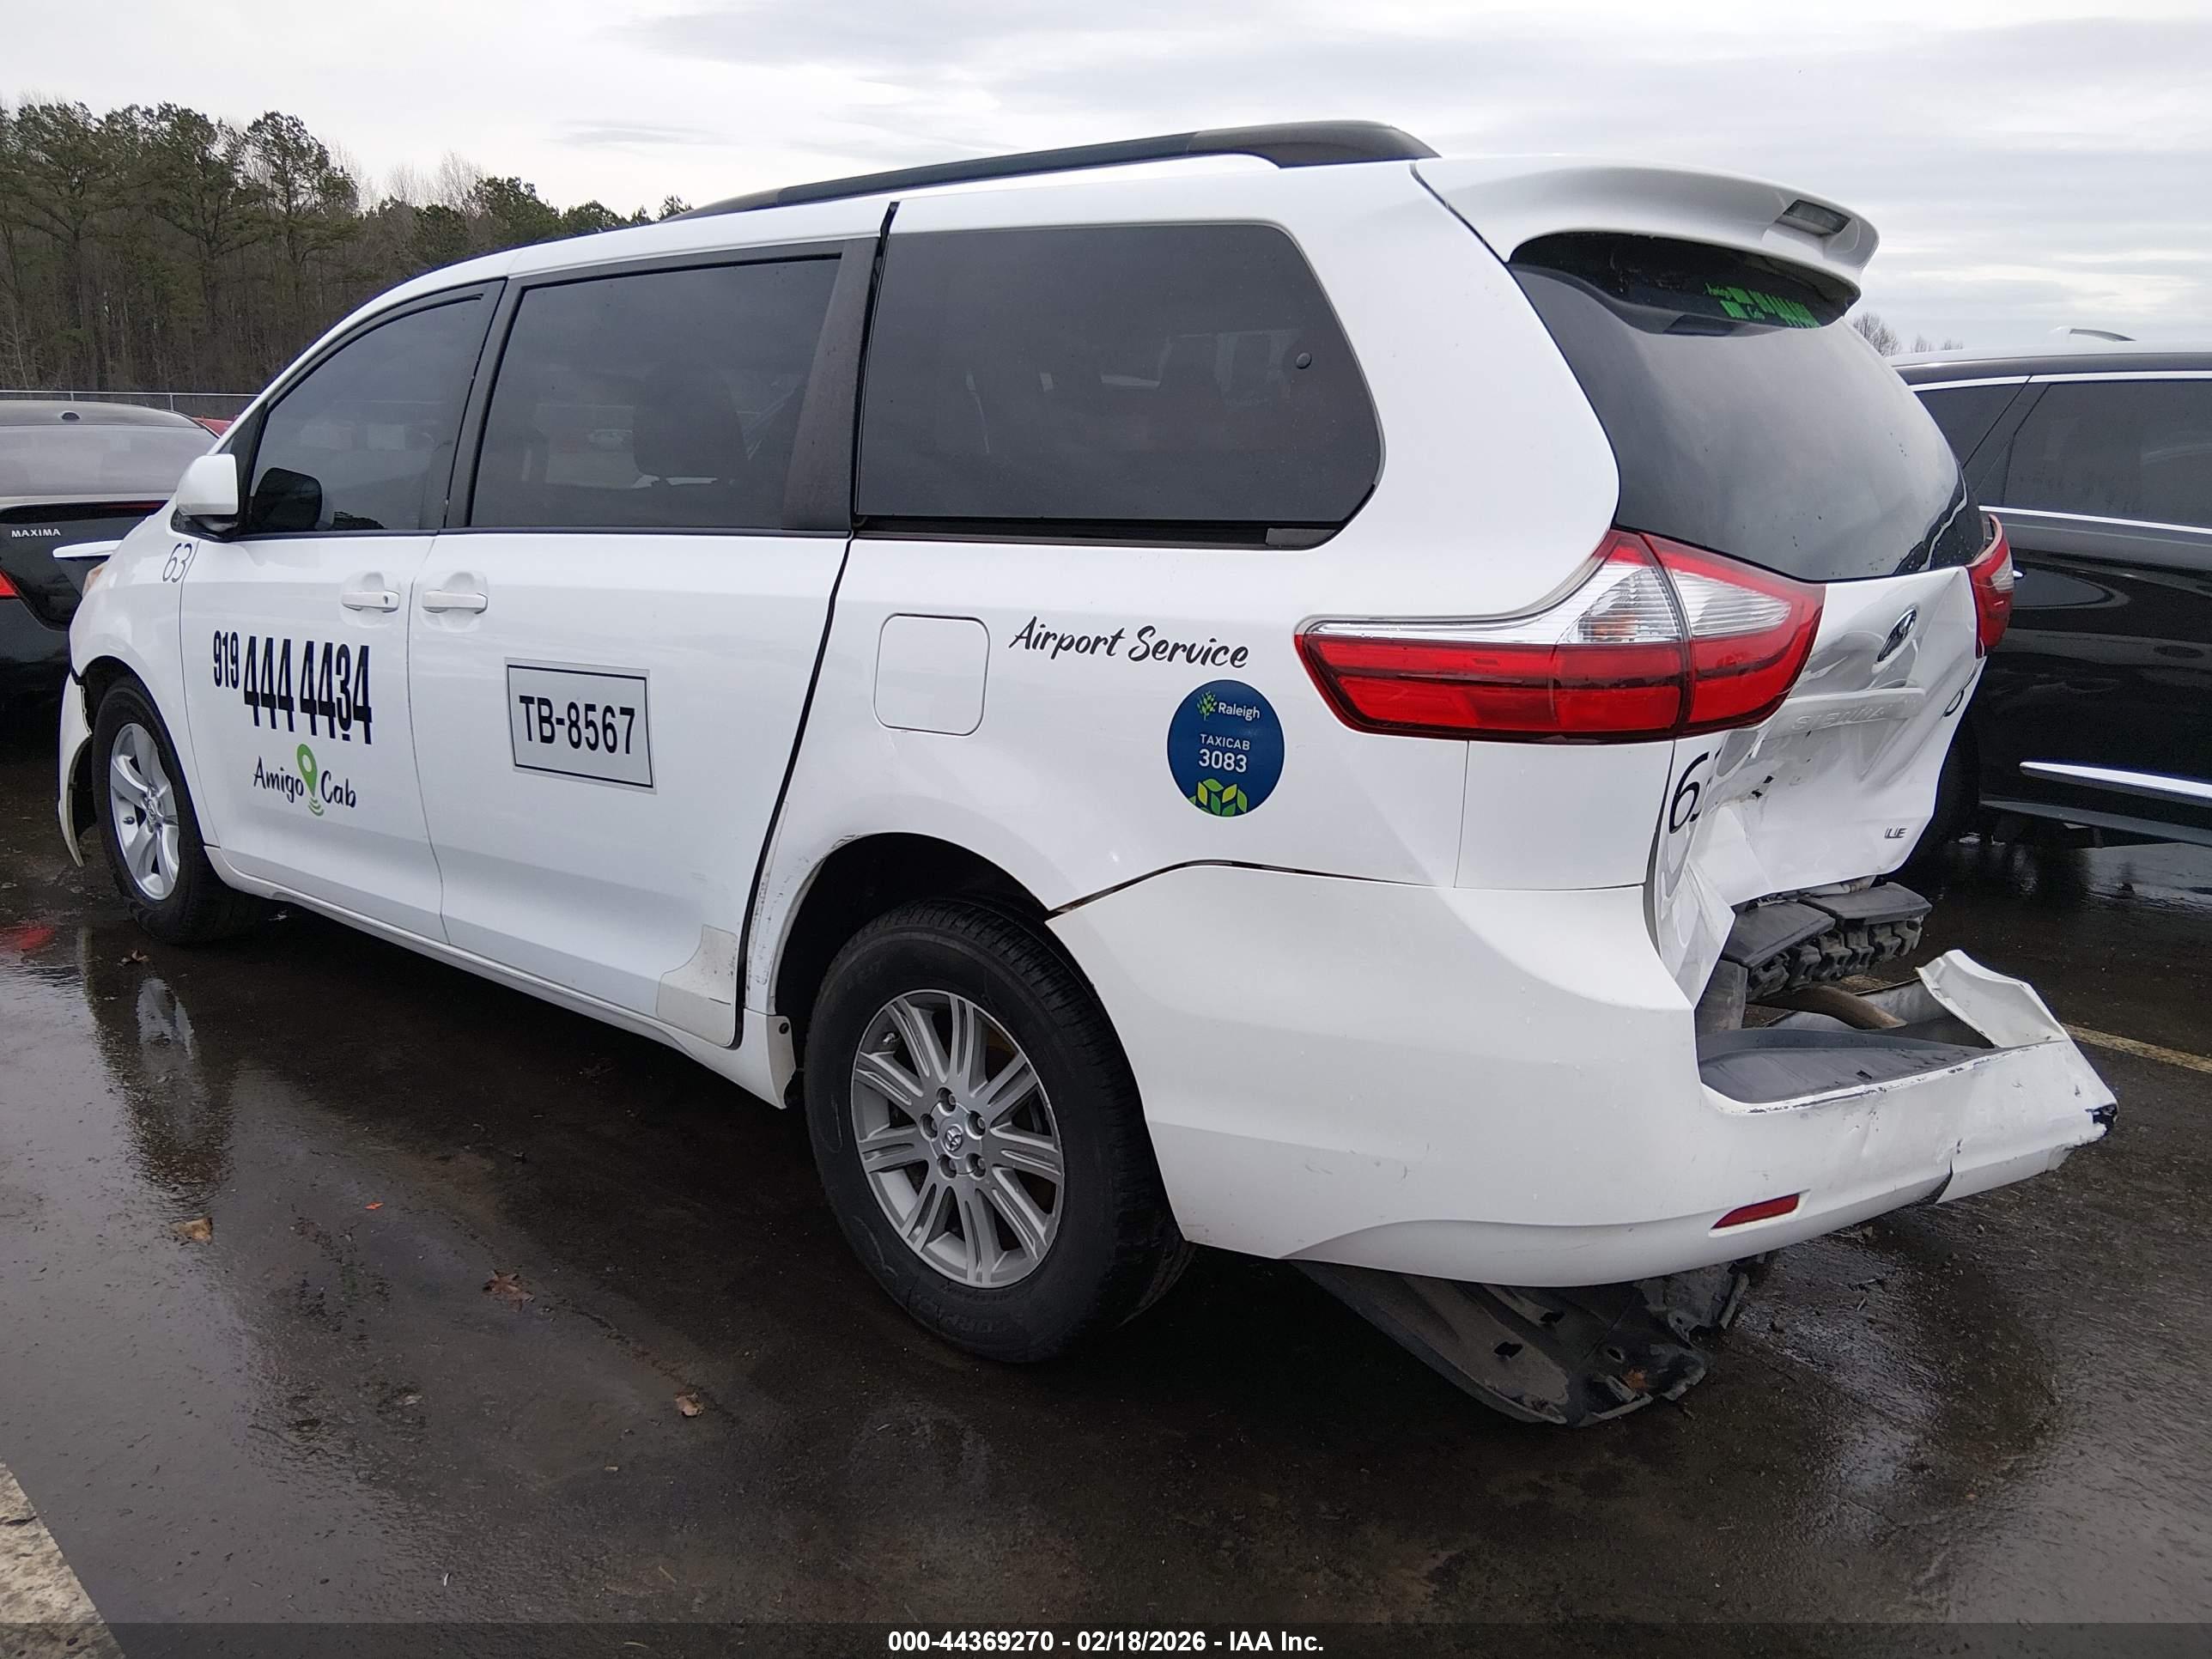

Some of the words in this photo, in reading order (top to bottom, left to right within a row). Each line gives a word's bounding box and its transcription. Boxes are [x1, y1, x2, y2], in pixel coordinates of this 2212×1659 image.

[11, 528, 62, 538] MAXIMA
[163, 543, 192, 583] 63
[1009, 617, 1126, 659] Airport
[1127, 625, 1249, 668] Service
[214, 629, 240, 690] 919
[244, 635, 295, 732] 444
[300, 641, 373, 745] 4434
[519, 695, 635, 755] TB-8567
[1218, 702, 1261, 721] Raleigh
[1198, 748, 1248, 773] 3083
[1200, 733, 1250, 750] TAXICAB
[253, 756, 304, 803] Amigo
[320, 770, 356, 808] Cab
